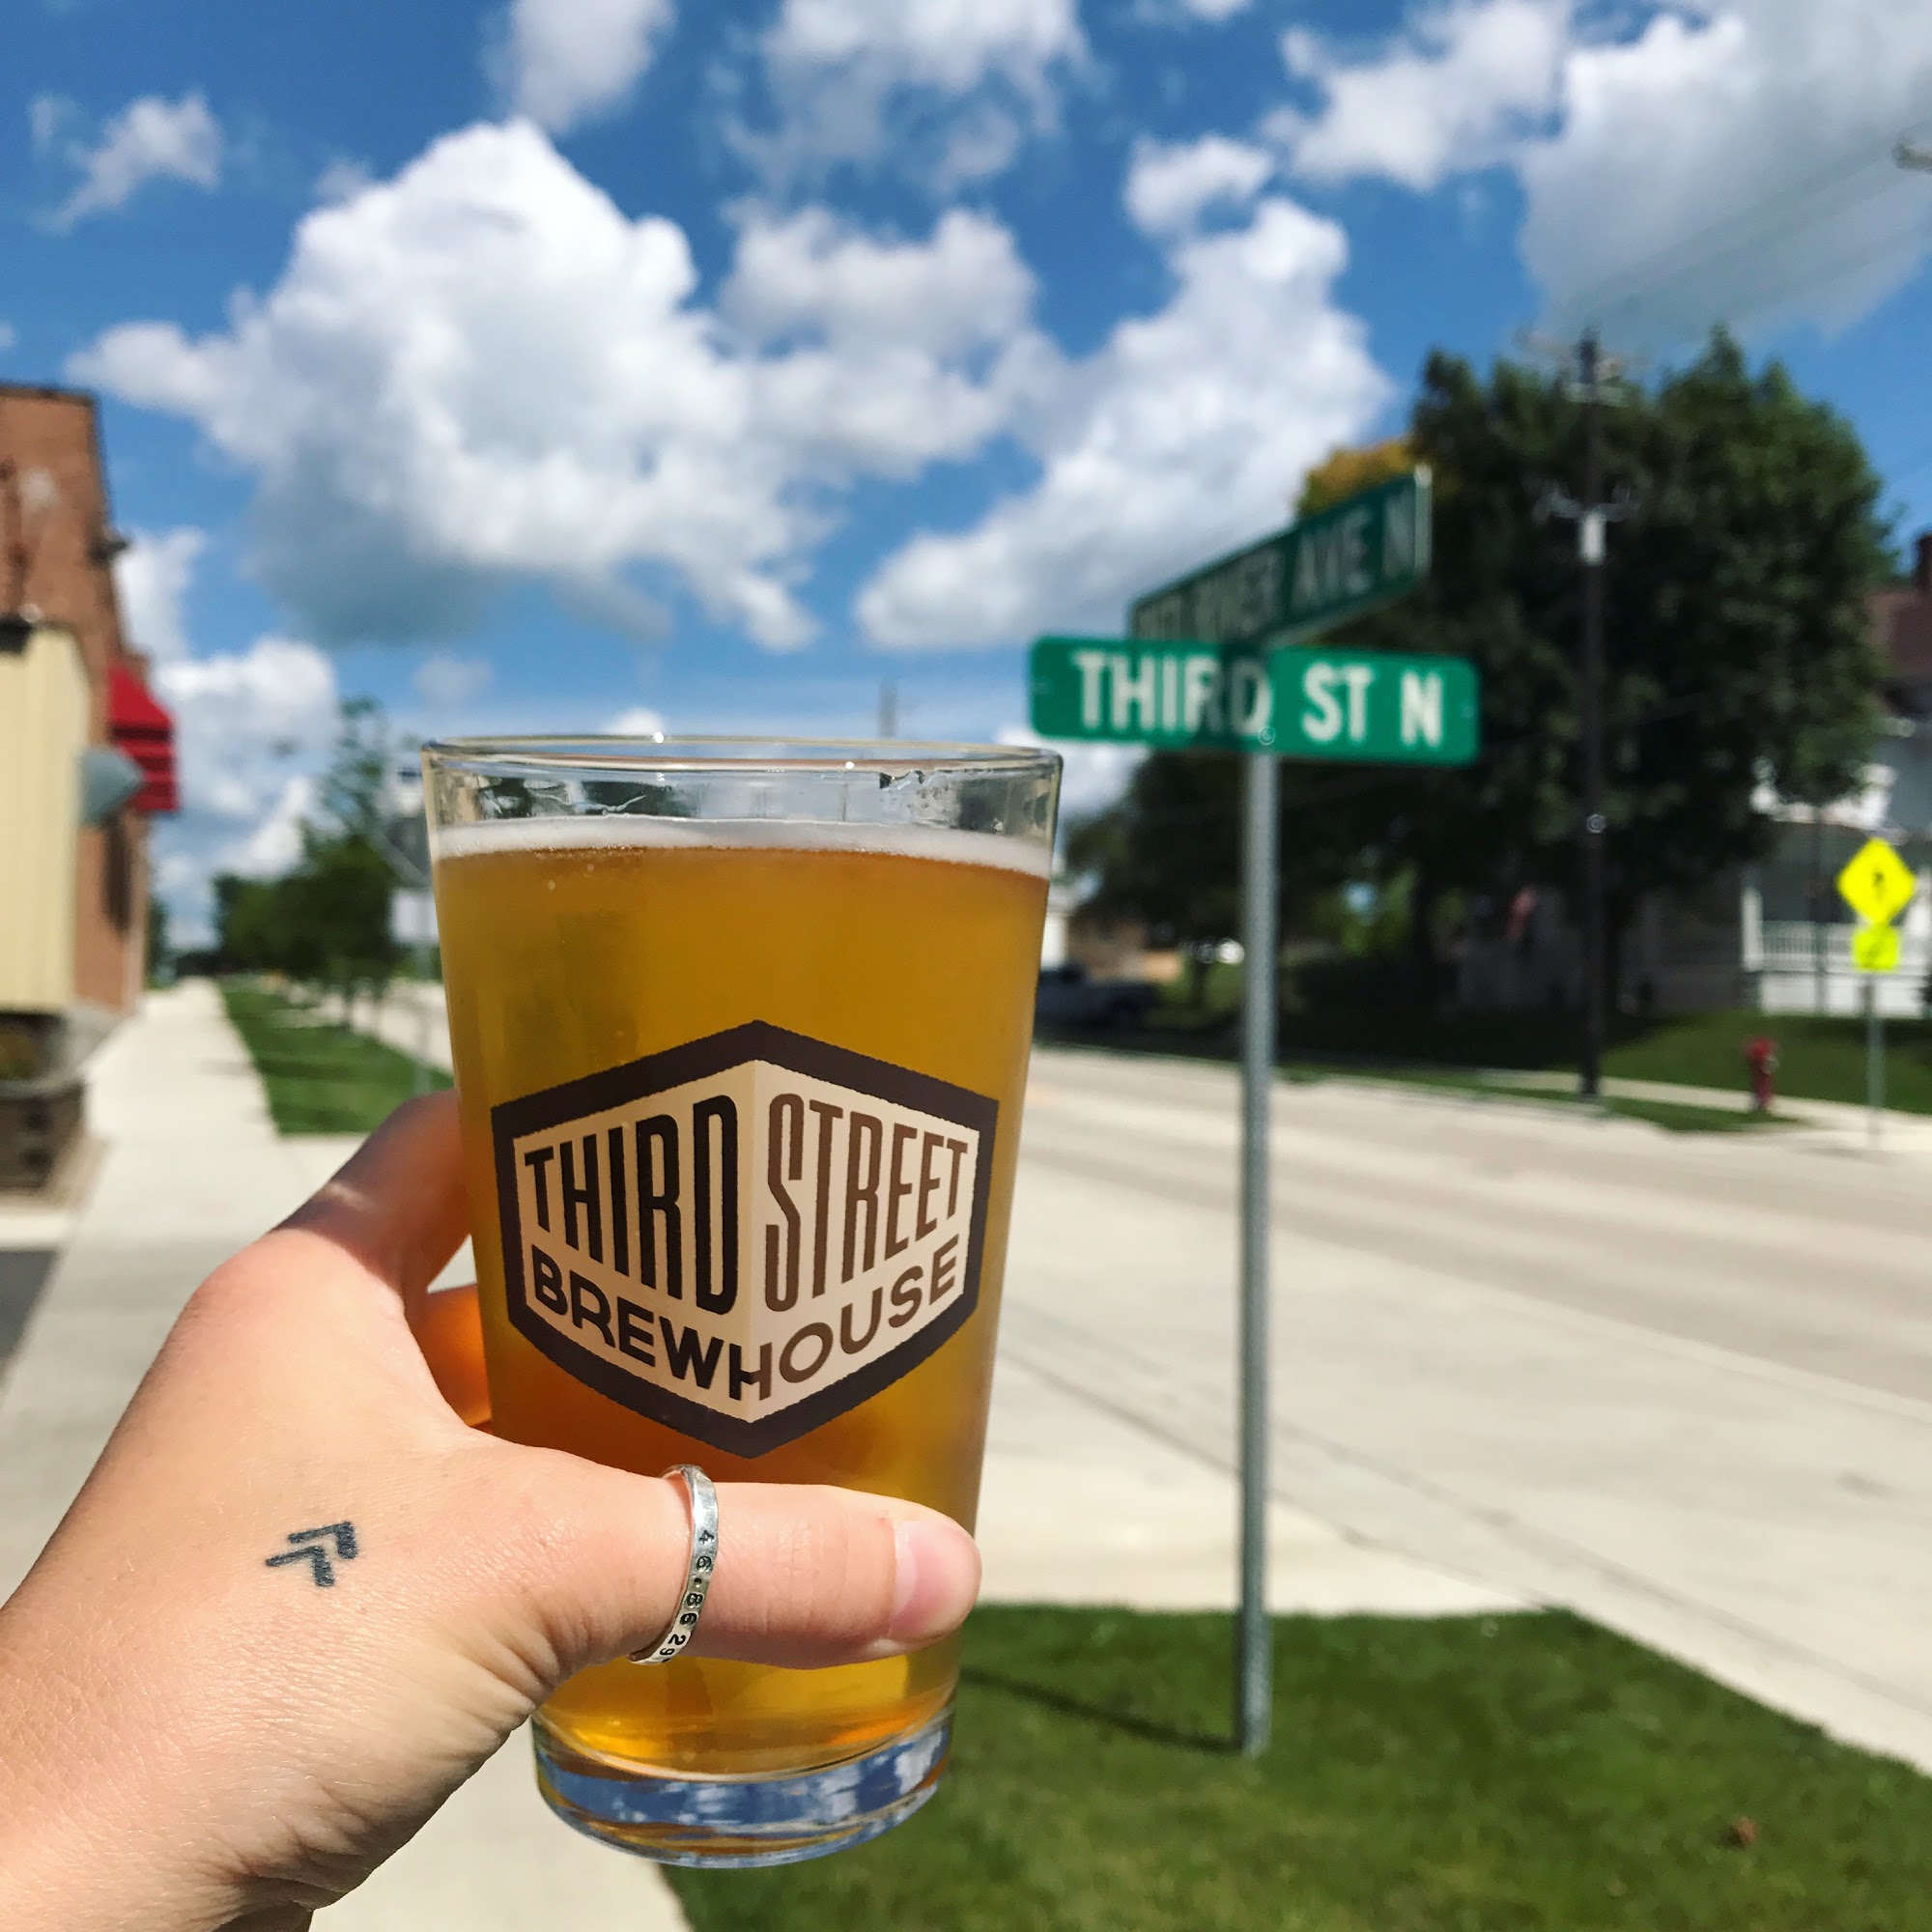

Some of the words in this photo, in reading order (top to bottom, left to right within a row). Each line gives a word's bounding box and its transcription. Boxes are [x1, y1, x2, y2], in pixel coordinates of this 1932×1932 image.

[1072, 651, 1273, 737] THIRD
[1302, 663, 1372, 744] ST
[1400, 670, 1443, 749] N
[524, 1094, 739, 1316] THIRD
[764, 1093, 969, 1312] STREET
[530, 1233, 960, 1402] BREWHOUSE
